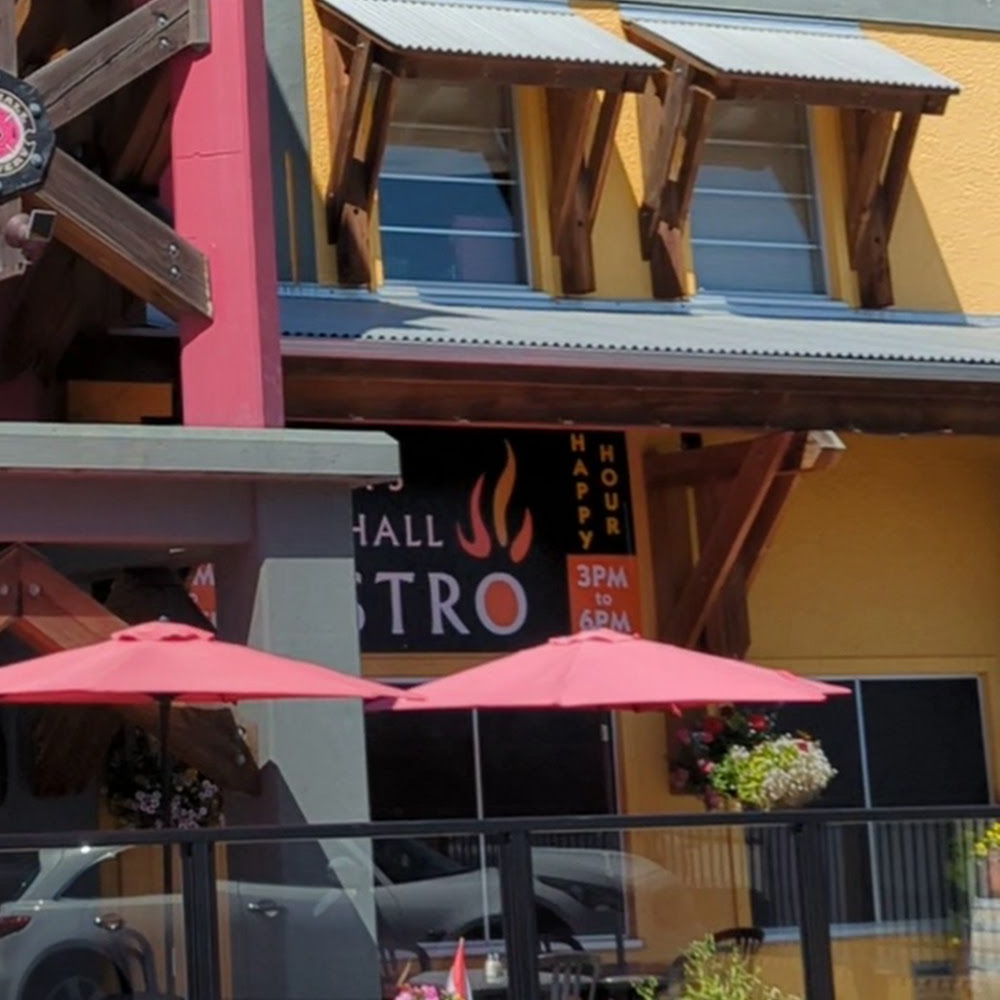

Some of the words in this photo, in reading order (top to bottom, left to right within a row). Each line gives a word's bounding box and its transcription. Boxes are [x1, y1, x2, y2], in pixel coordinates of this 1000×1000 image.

[569, 433, 594, 550] HAPPY
[600, 444, 620, 535] HOUR
[576, 564, 629, 589] 3PM
[355, 571, 528, 636] TRO
[579, 609, 631, 633] 6PM
[595, 592, 613, 607] to
